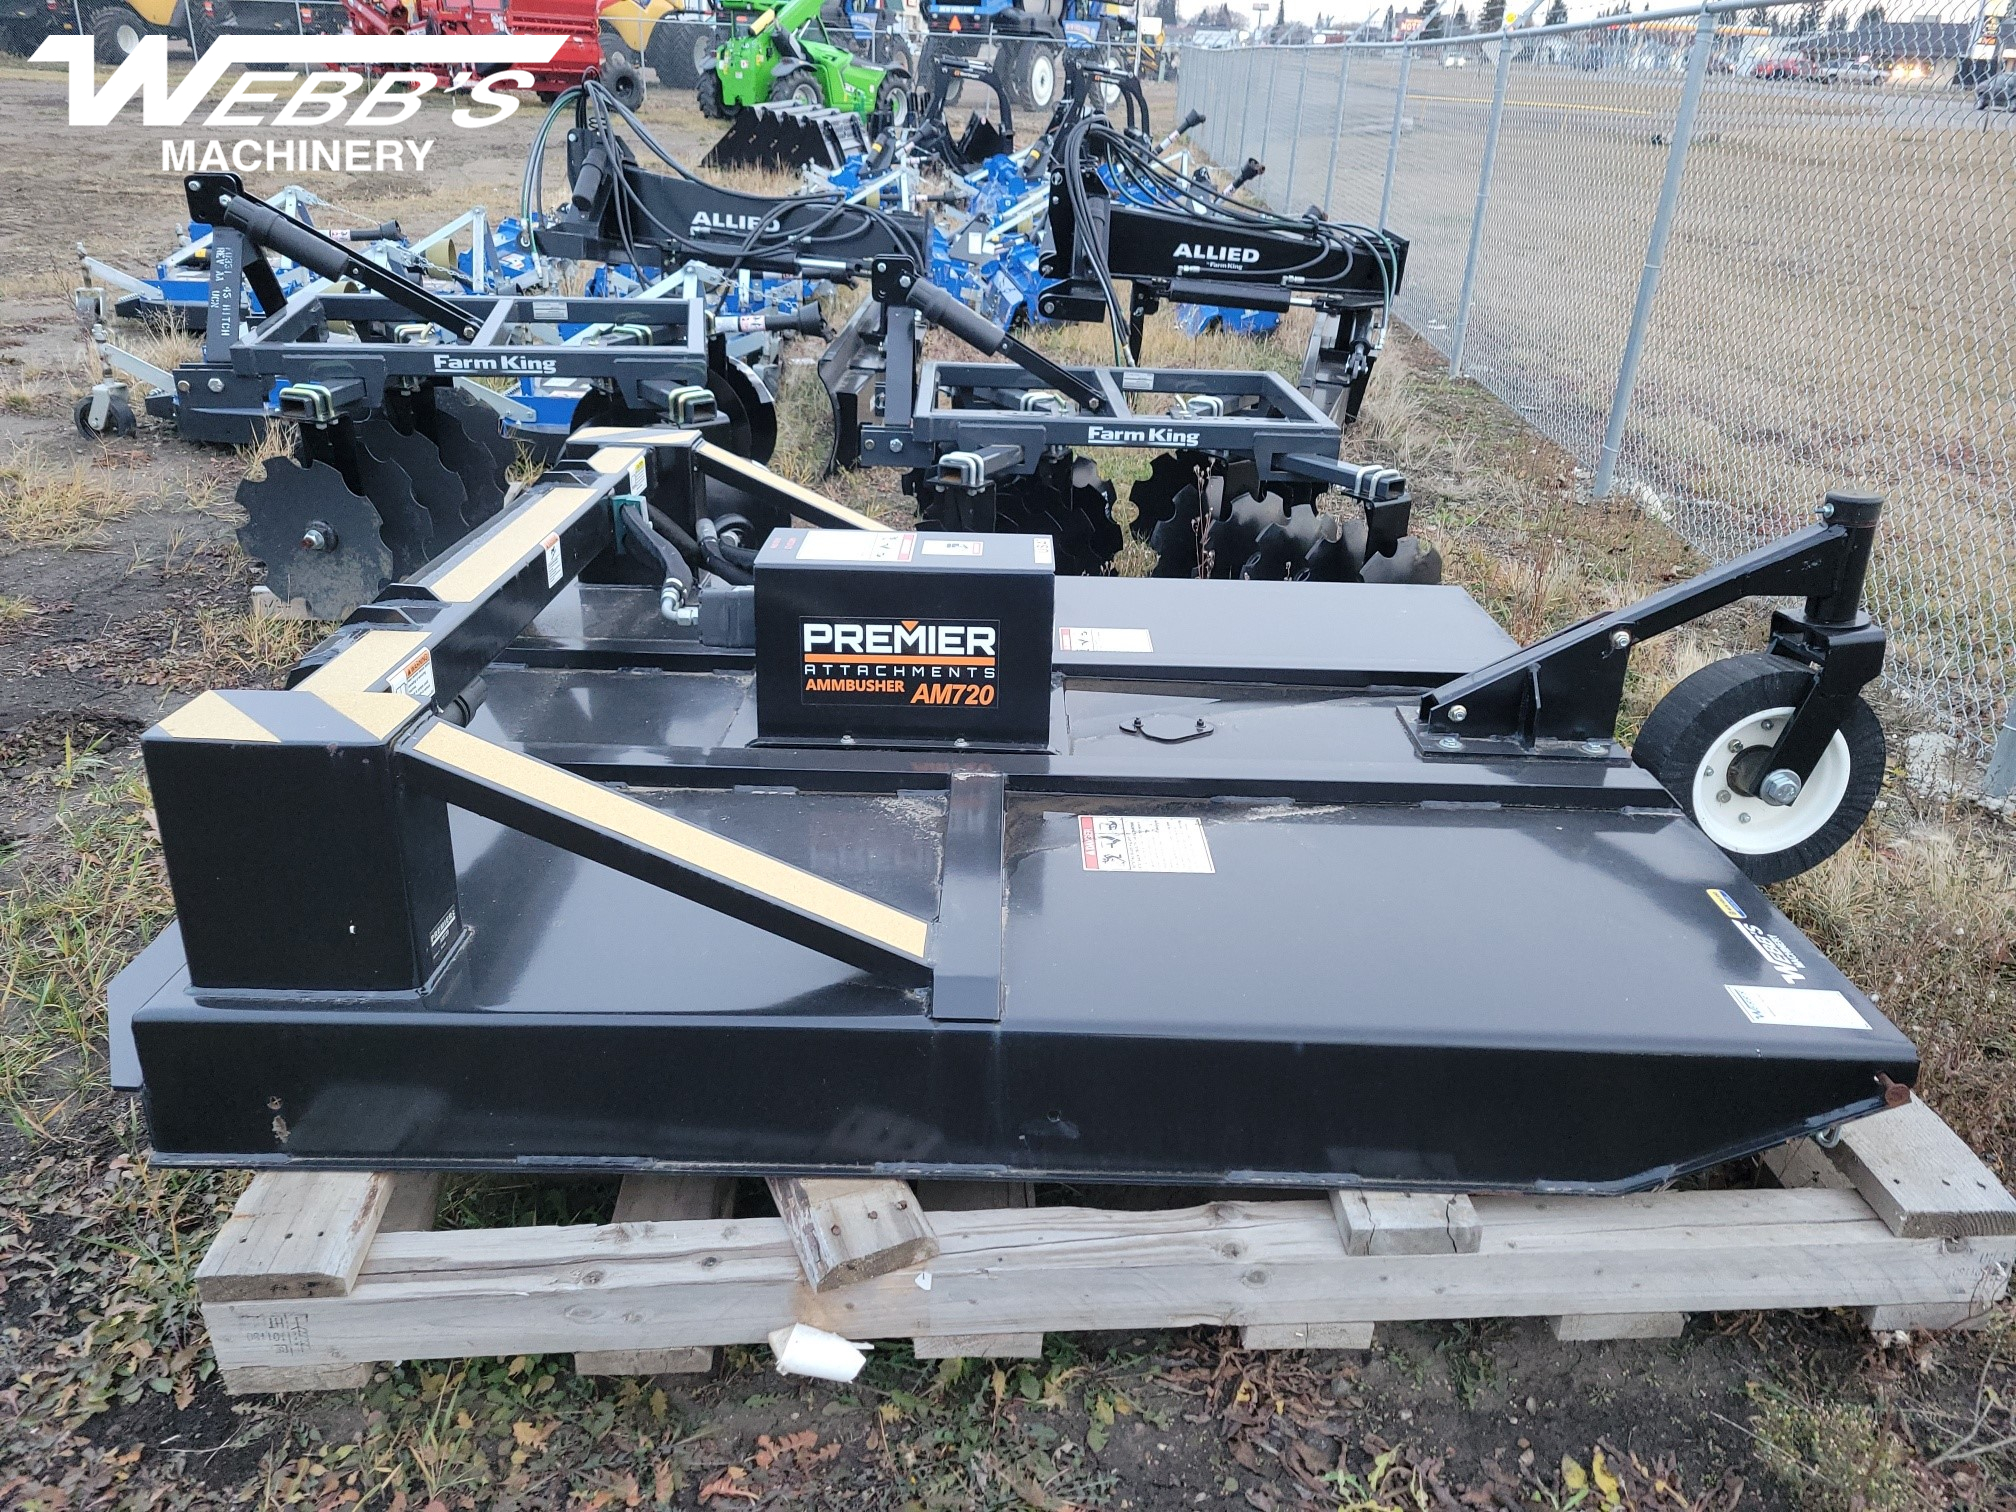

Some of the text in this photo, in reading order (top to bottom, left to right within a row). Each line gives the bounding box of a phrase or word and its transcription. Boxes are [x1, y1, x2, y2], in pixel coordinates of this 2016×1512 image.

[1172, 242, 1260, 264] ALLIED
[221, 304, 231, 336] HITCH
[433, 354, 557, 375] Farm King
[1088, 426, 1200, 447] Farm King
[803, 623, 996, 656] PREMIER
[804, 664, 996, 679] ATTACHMENTS
[805, 678, 995, 706] AMMBUSHER AM720
